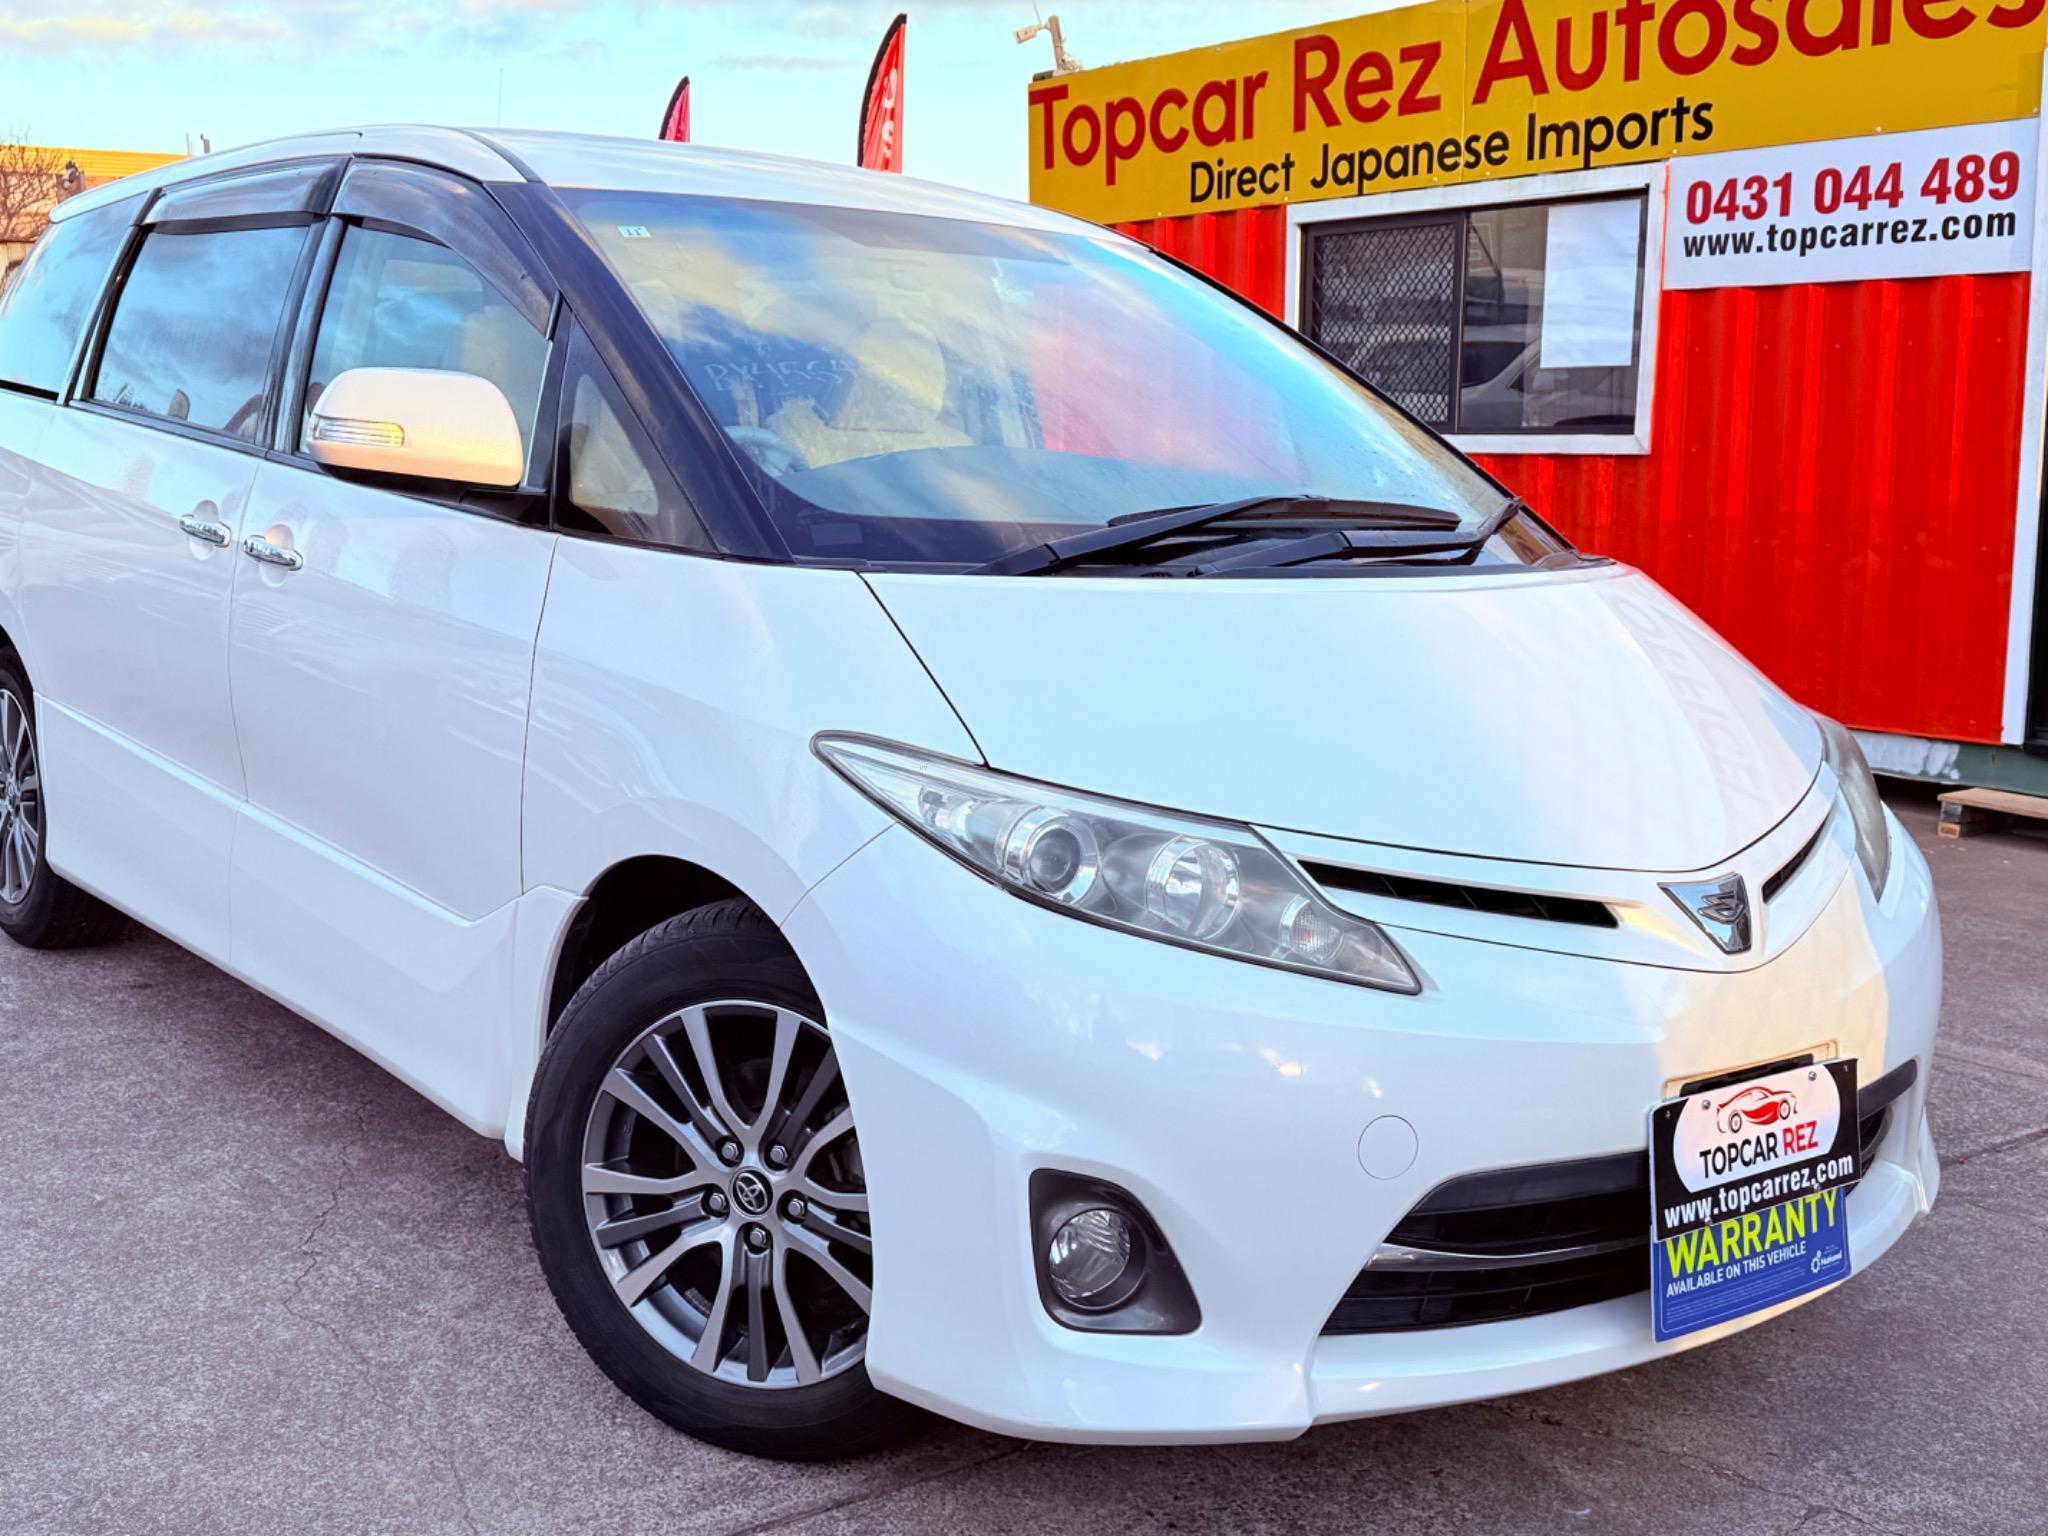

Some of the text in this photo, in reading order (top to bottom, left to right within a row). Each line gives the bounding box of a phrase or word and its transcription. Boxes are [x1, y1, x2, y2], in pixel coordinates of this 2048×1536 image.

[1028, 0, 2046, 186] Topcar Rez Autosa
[1190, 97, 1713, 203] Direct Japanese Imports
[1686, 151, 2020, 225] 0431 044 489
[1683, 211, 2016, 257] www.topcarrez.com
[1699, 1120, 1819, 1179] TOPCAR REZ
[1664, 1154, 1854, 1229] www.topcarrez.com
[1665, 1187, 1837, 1279] WARRANTY
[1666, 1267, 1724, 1298] AVAILABLE
[1725, 1262, 1741, 1279] ON
[1742, 1253, 1766, 1274] THIS
[1767, 1240, 1807, 1266] VEHICLE
